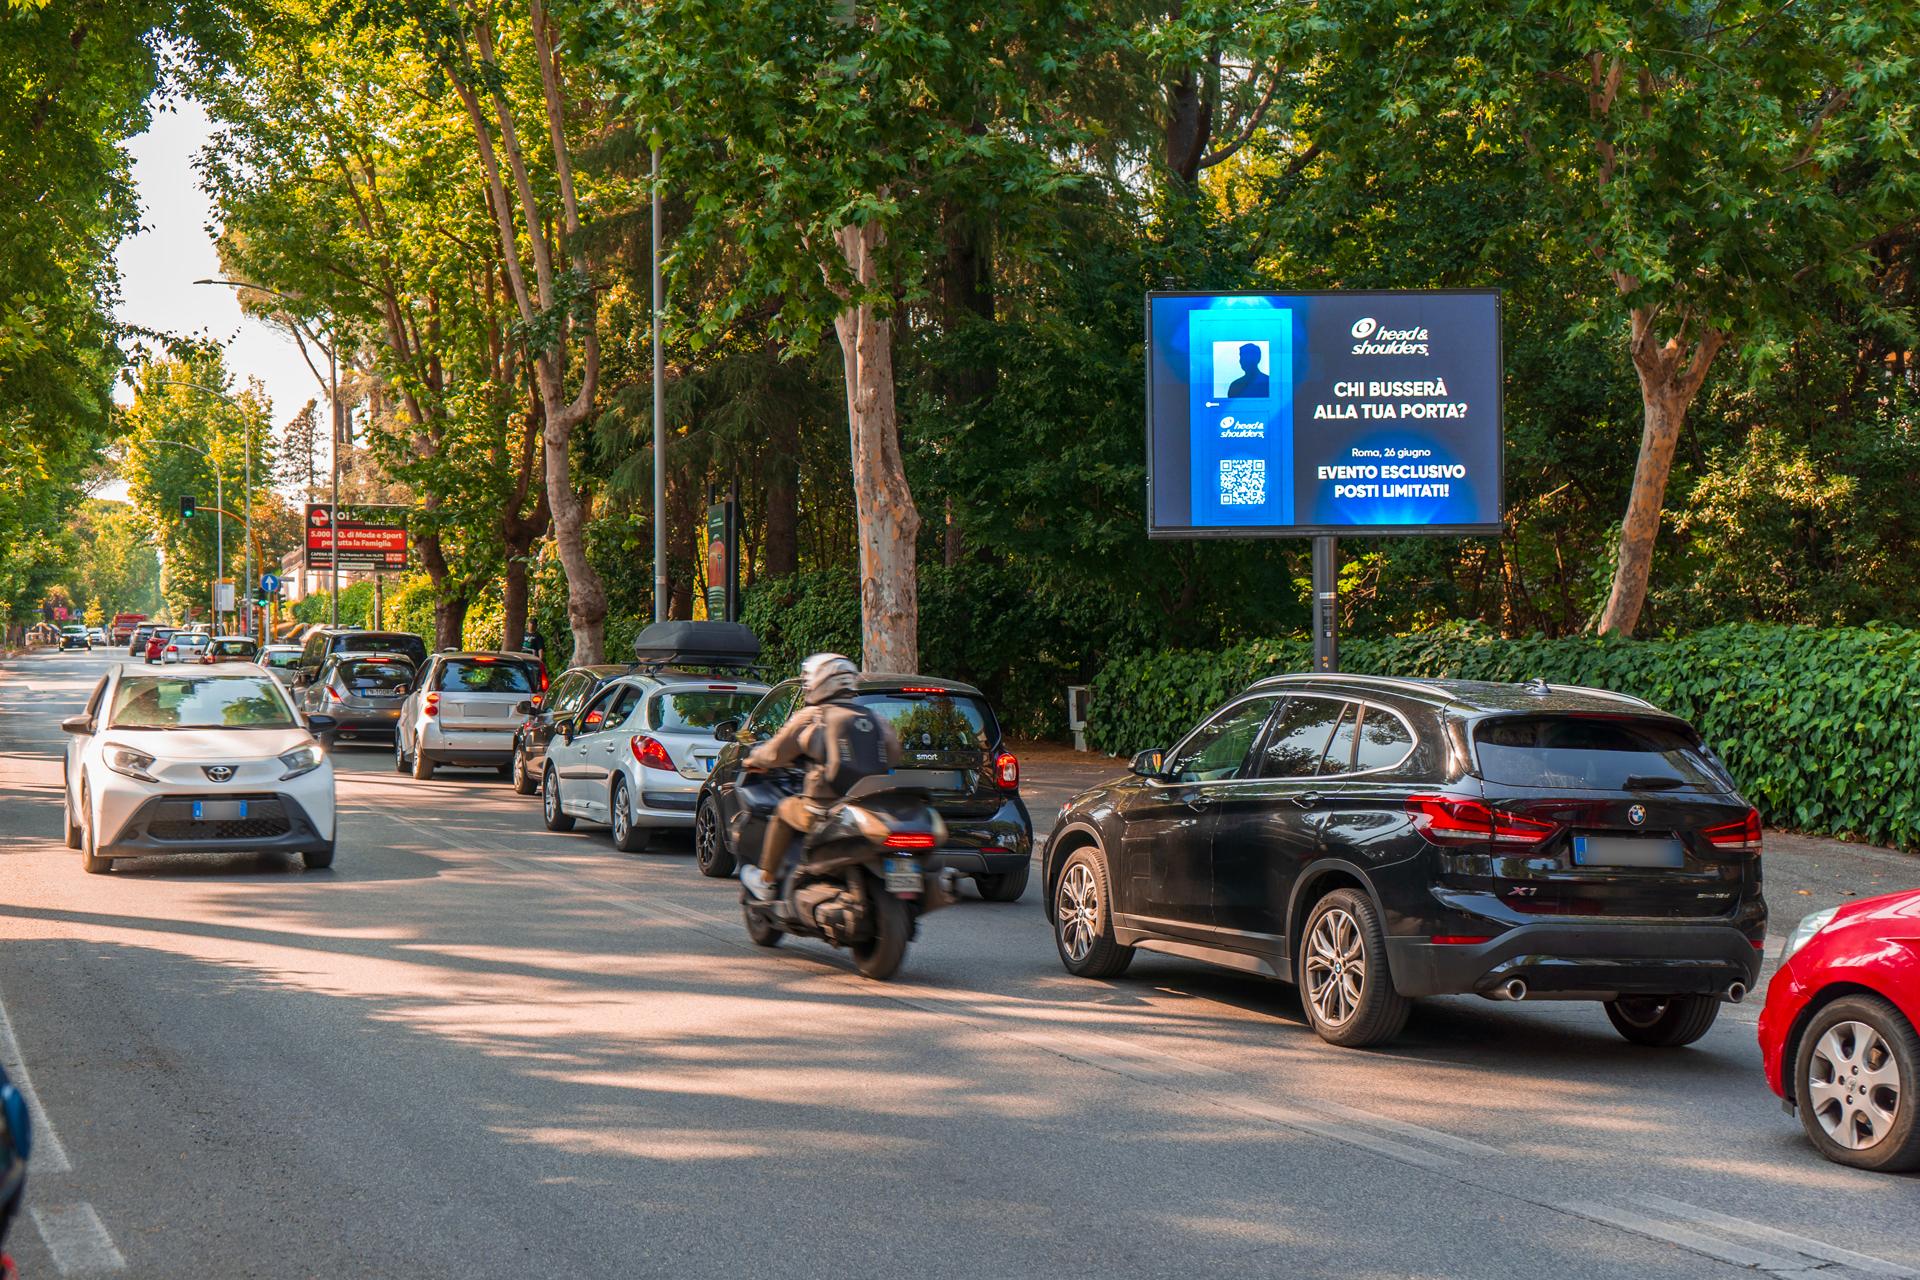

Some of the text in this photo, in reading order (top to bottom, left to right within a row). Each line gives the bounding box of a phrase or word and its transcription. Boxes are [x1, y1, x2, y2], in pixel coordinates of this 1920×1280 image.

[1334, 377, 1447, 397] CHI BUSSERÀ
[1314, 403, 1467, 419] ALLA TUA PORTA?
[1352, 448, 1431, 458] Roma, 26 giugno
[1318, 465, 1466, 479] EVENTO ESCLUSIVO
[1334, 484, 1450, 498] POSTI LIMITATI!
[347, 531, 354, 539] di
[355, 531, 375, 539] Moda
[382, 532, 402, 540] Sport
[361, 540, 391, 548] Famiglia
[916, 753, 938, 761] smart
